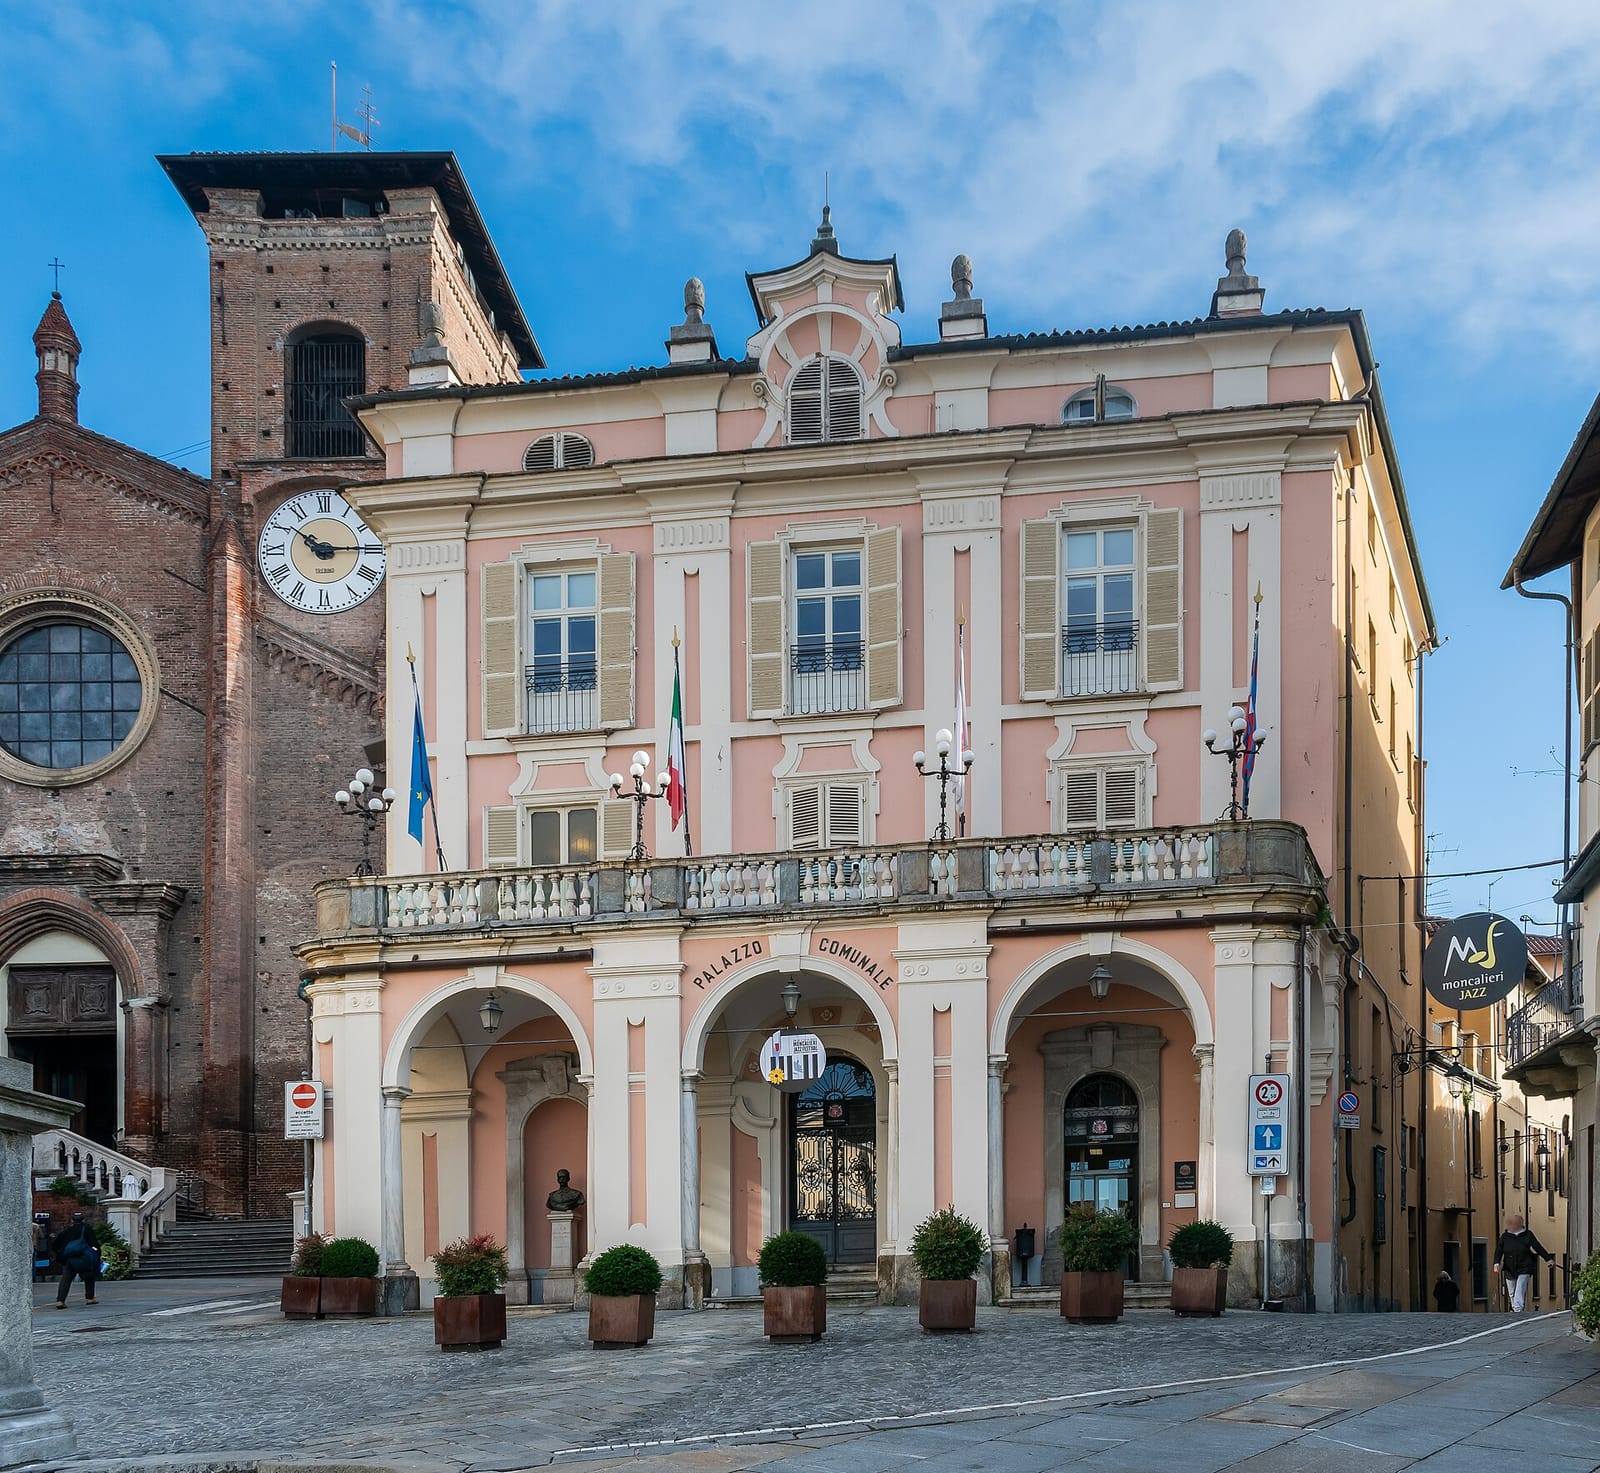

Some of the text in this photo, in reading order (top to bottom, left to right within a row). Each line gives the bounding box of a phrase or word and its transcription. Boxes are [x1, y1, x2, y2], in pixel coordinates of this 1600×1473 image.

[289, 502, 308, 523] XI
[316, 495, 331, 513] XII
[272, 522, 291, 535] X
[266, 542, 285, 556] IX
[270, 563, 291, 585] VIII
[289, 580, 307, 602] VII
[318, 589, 331, 607] VI
[345, 583, 359, 600] V
[692, 936, 895, 991] PALAZZO COMUNALE
[1442, 970, 1504, 991] moncalieri
[1458, 987, 1488, 1001] JAZZ
